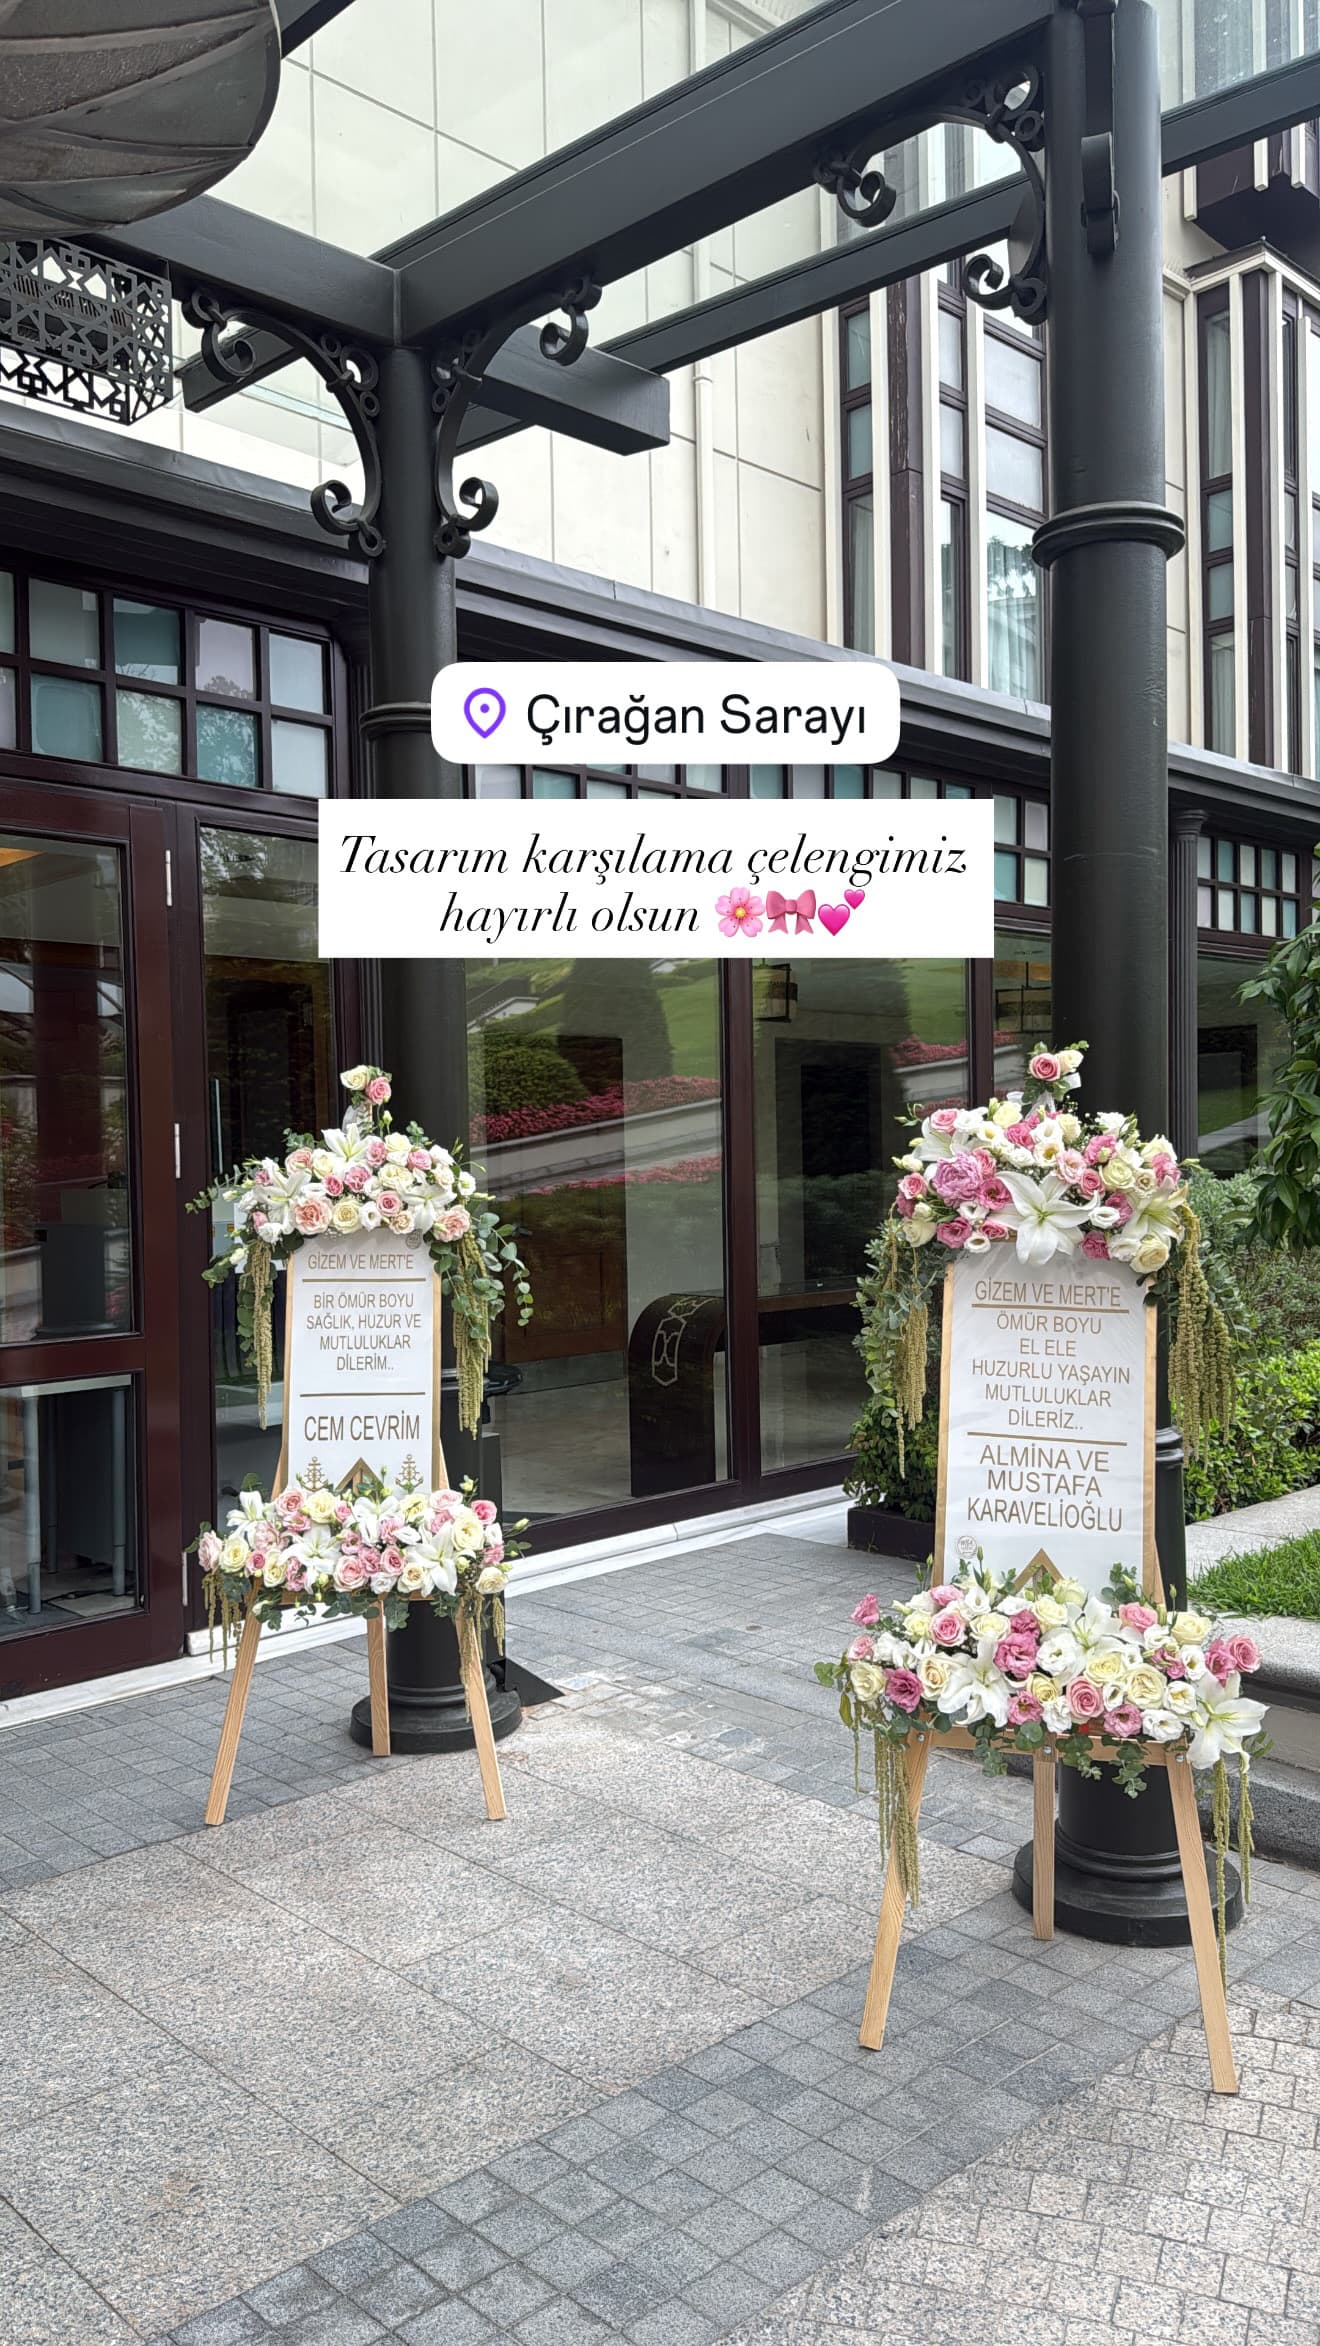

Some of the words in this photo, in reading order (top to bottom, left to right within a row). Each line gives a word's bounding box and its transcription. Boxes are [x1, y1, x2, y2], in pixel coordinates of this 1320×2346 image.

[308, 1252, 348, 1270] GİZEM
[350, 1254, 366, 1270] VE
[369, 1254, 414, 1270] MERT'E
[313, 1291, 335, 1309] BİR
[337, 1291, 376, 1309] ÖMÜR
[379, 1292, 414, 1308] BOYU
[975, 1276, 1028, 1302] GİZEM
[1032, 1283, 1055, 1304] VE
[1058, 1285, 1121, 1307] MERT'E
[306, 1311, 355, 1330] SAĞLIK,
[358, 1314, 402, 1329] HUZUR
[404, 1313, 422, 1328] VE
[996, 1310, 1048, 1333] ÖMÜR
[1053, 1316, 1102, 1335] BOYU
[319, 1334, 411, 1351] MUTLULUKLAR
[1019, 1338, 1041, 1356] EL
[1044, 1340, 1077, 1357] ELE
[971, 1359, 1053, 1380] HUZURLU
[1057, 1363, 1130, 1386] YAŞAYIN
[985, 1383, 1112, 1407] MUTLULUKLAR
[304, 1415, 344, 1441] CEM
[350, 1410, 420, 1441] CEVRİM
[979, 1443, 1071, 1471] ALMİNA
[1078, 1450, 1110, 1473] VE
[987, 1470, 1103, 1497] MUSTAFA
[967, 1497, 1123, 1532] KARAVELİOĞLU
